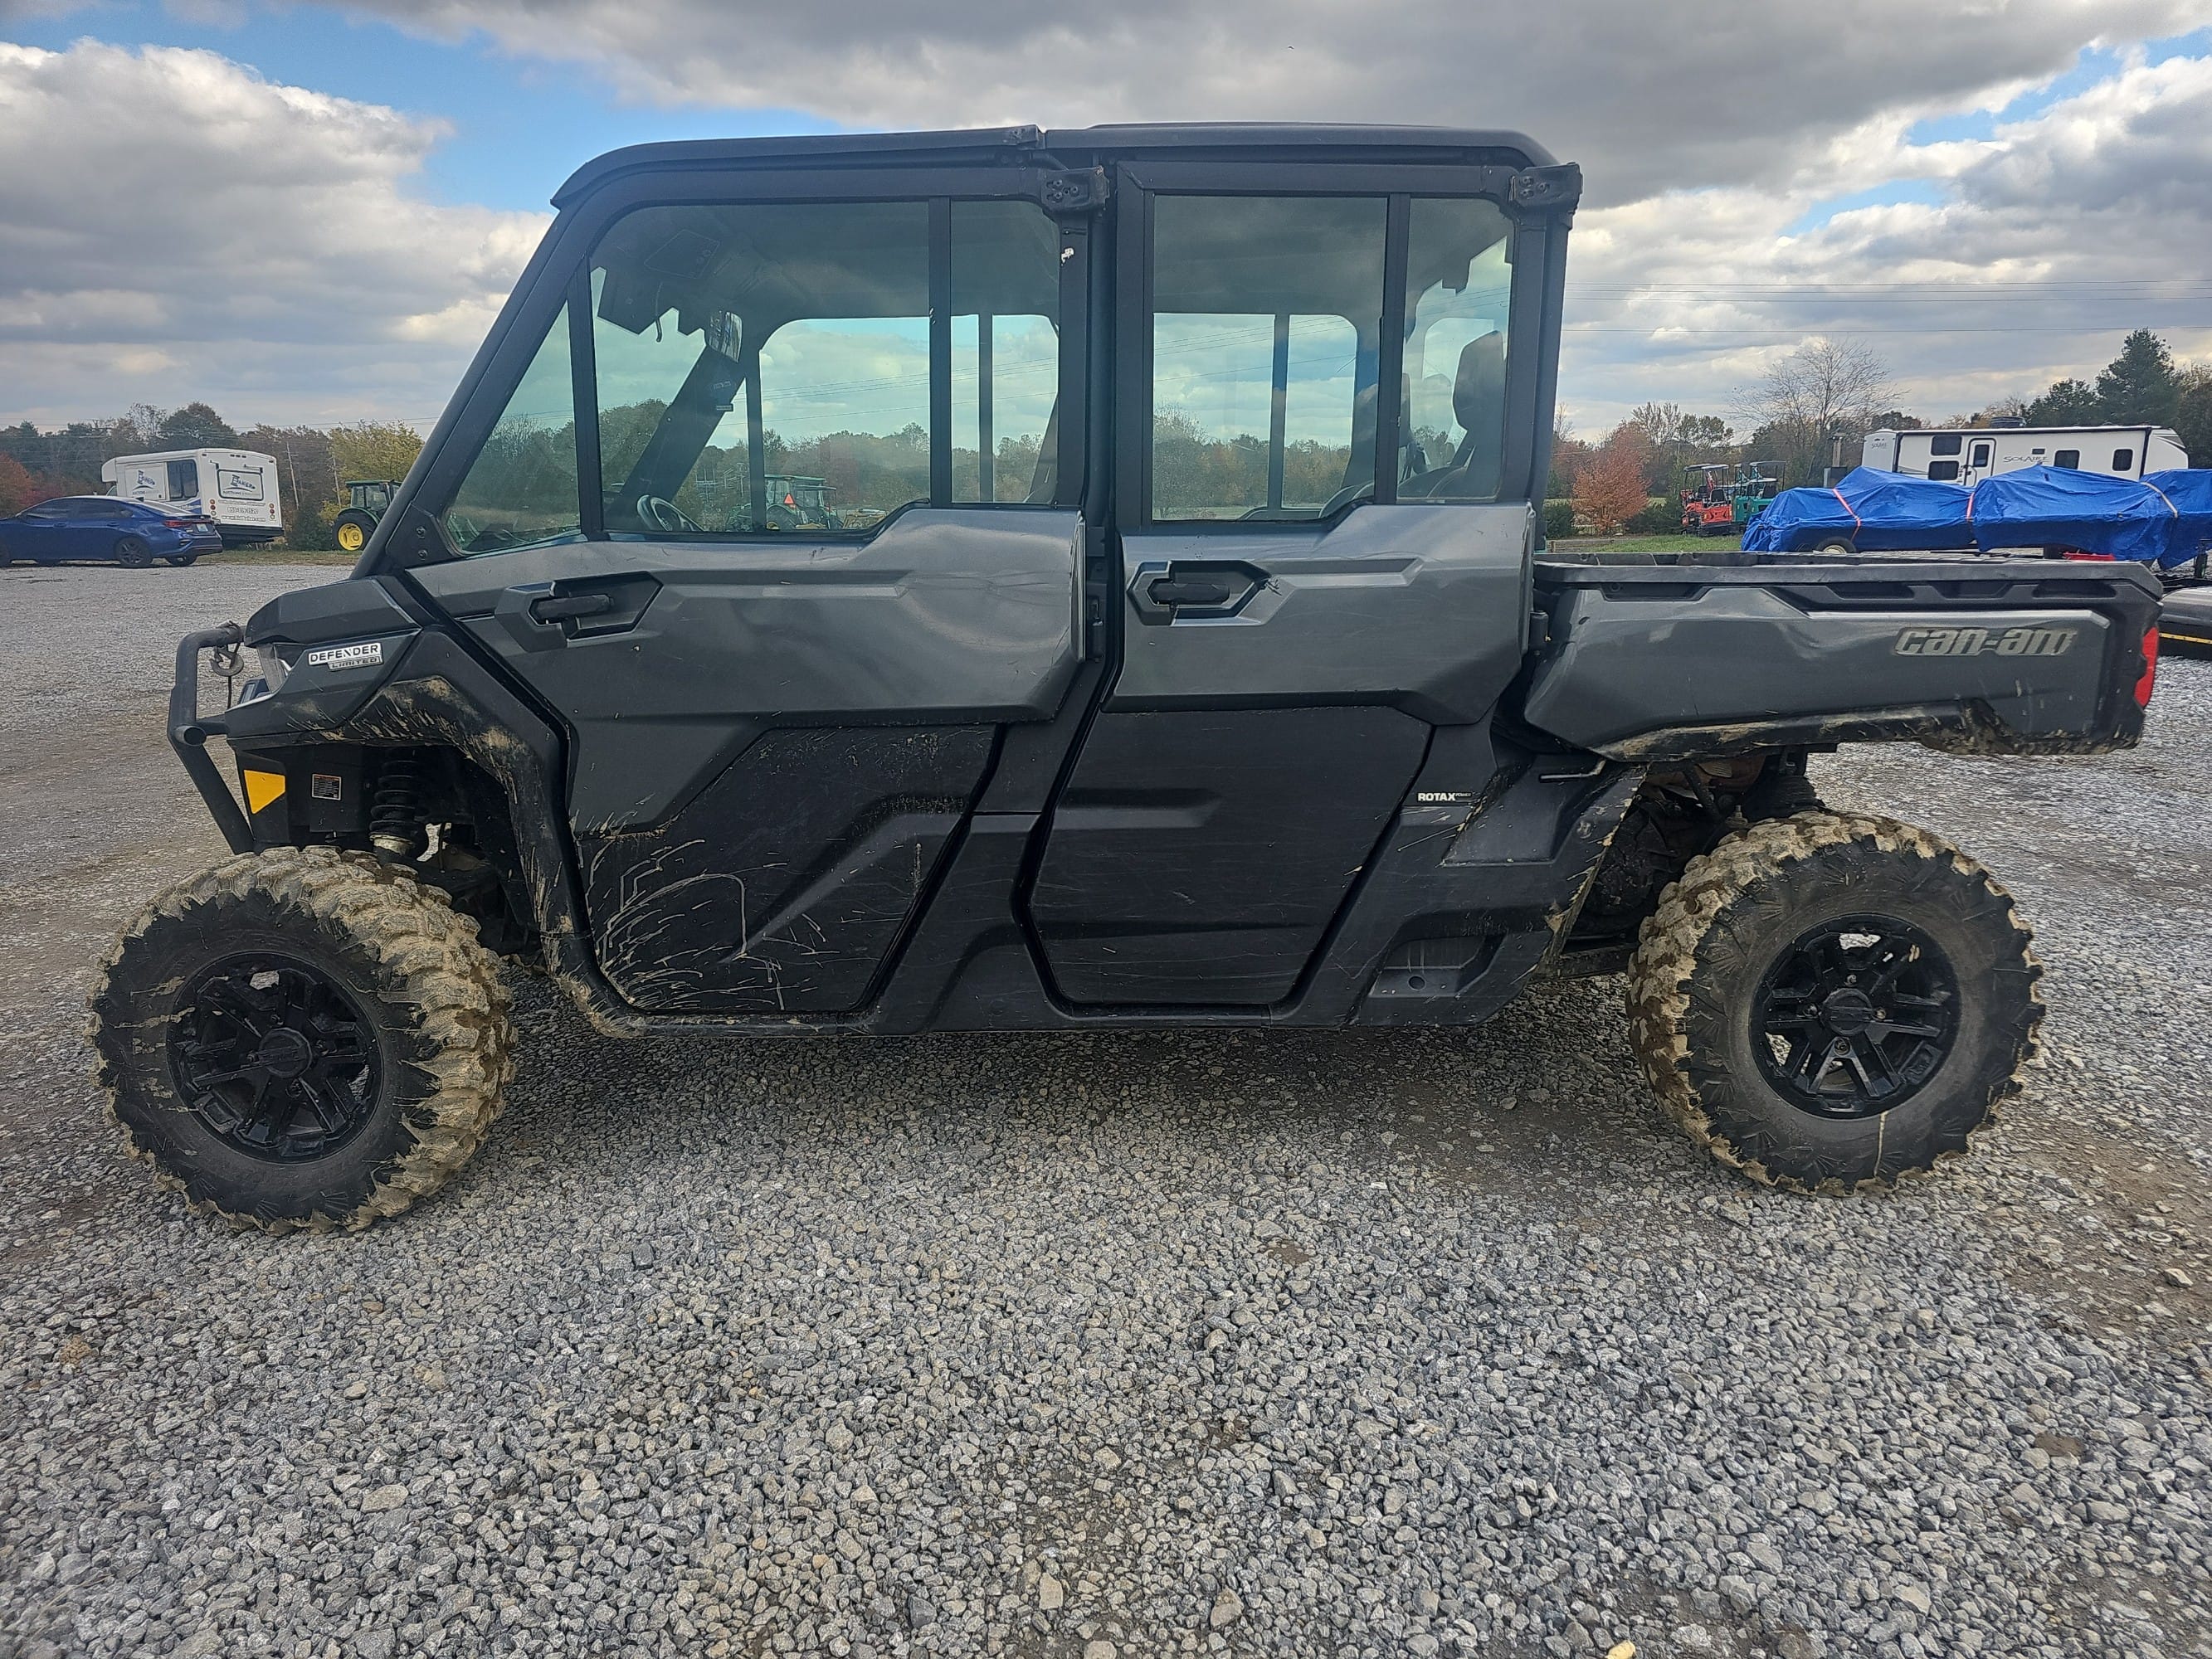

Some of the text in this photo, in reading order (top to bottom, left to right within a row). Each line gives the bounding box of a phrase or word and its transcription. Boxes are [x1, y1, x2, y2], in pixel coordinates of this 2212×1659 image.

[310, 644, 379, 663] DEFENDER
[332, 657, 378, 669] LIMITED
[1417, 792, 1456, 801] ROTAX
